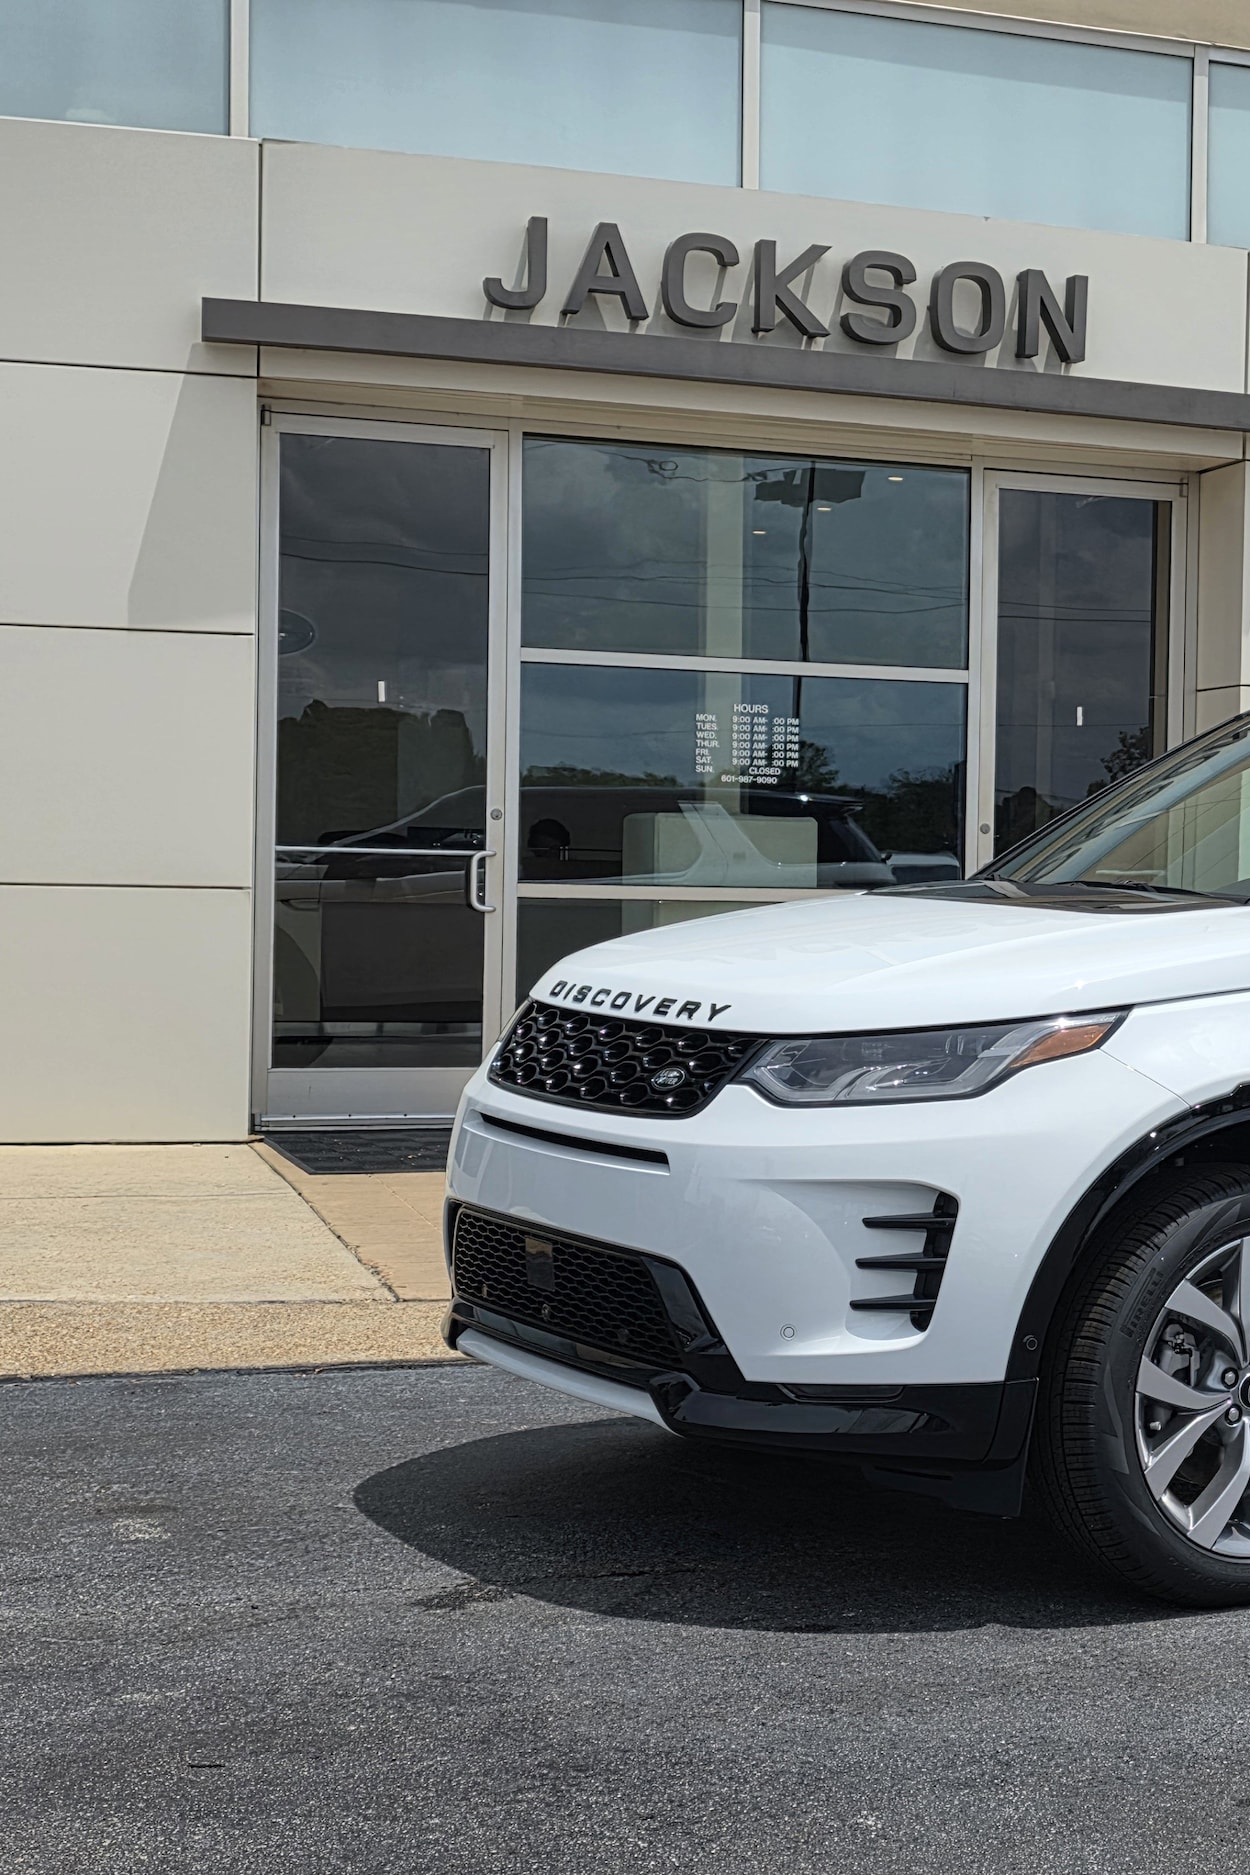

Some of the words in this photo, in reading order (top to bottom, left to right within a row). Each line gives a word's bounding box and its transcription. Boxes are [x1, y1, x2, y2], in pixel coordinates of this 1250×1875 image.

[483, 216, 1090, 364] JACKSON
[733, 704, 769, 714] HOURS
[695, 713, 717, 722] MON.
[695, 722, 719, 731] TUES.
[696, 731, 717, 740] WED.
[695, 739, 720, 748] THUR.
[695, 748, 710, 756] FRI.
[695, 755, 713, 764] SAT.
[749, 766, 781, 775] CLOSED
[721, 774, 778, 784] 601-987-9090
[549, 980, 732, 1022] DISCOVERY
[1119, 1268, 1164, 1338] PIRELLI
